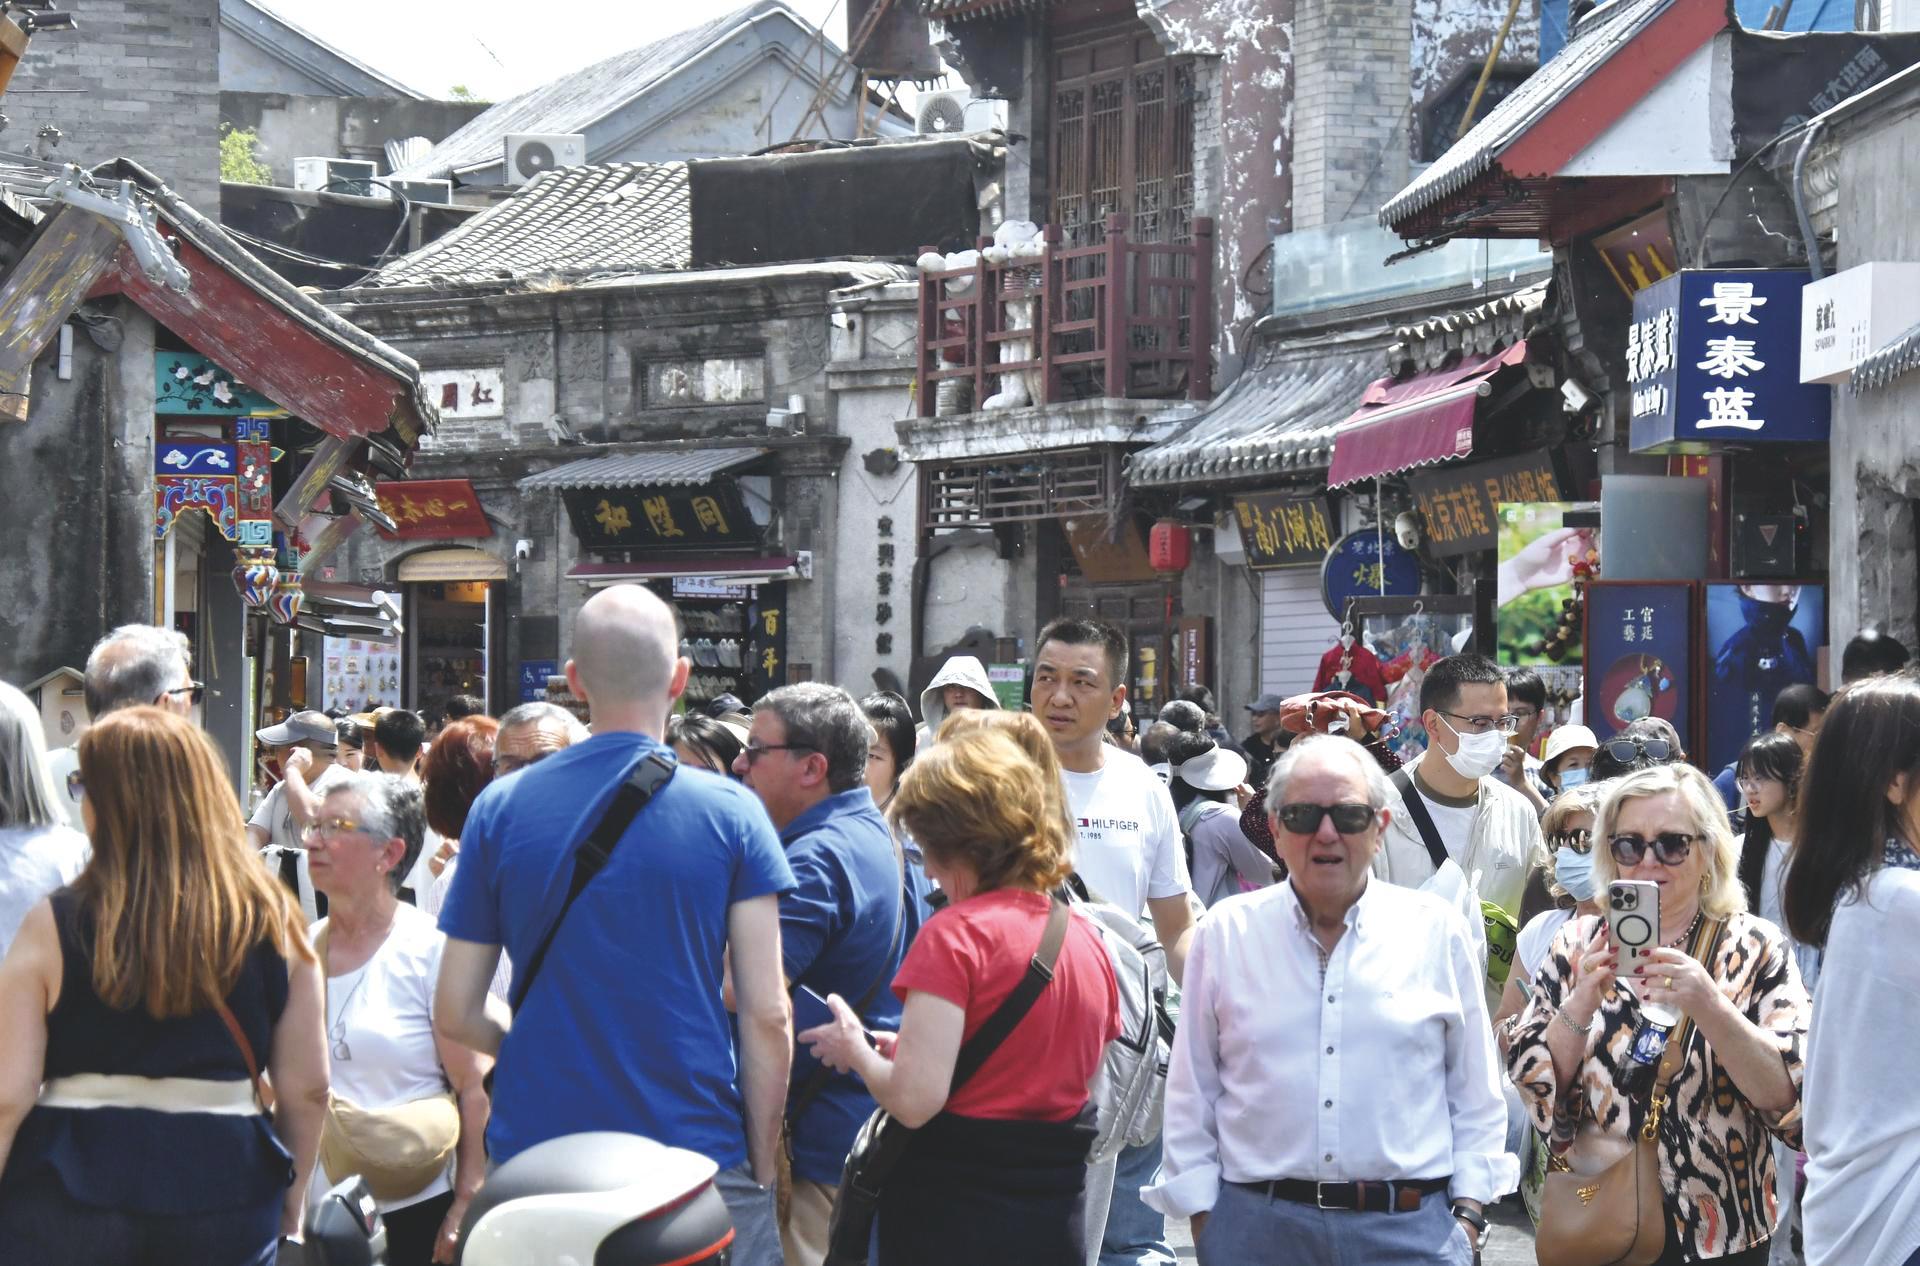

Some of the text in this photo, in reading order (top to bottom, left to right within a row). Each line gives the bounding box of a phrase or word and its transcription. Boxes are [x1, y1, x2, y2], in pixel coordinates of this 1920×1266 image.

[1695, 281, 1768, 431] 景泰蓝
[1252, 501, 1330, 556] 南门涮肉
[1419, 481, 1490, 544] 北京布鞋
[761, 608, 780, 679] 百年
[1087, 832, 1102, 840] 1985
[1092, 818, 1138, 831] HILFIGER
